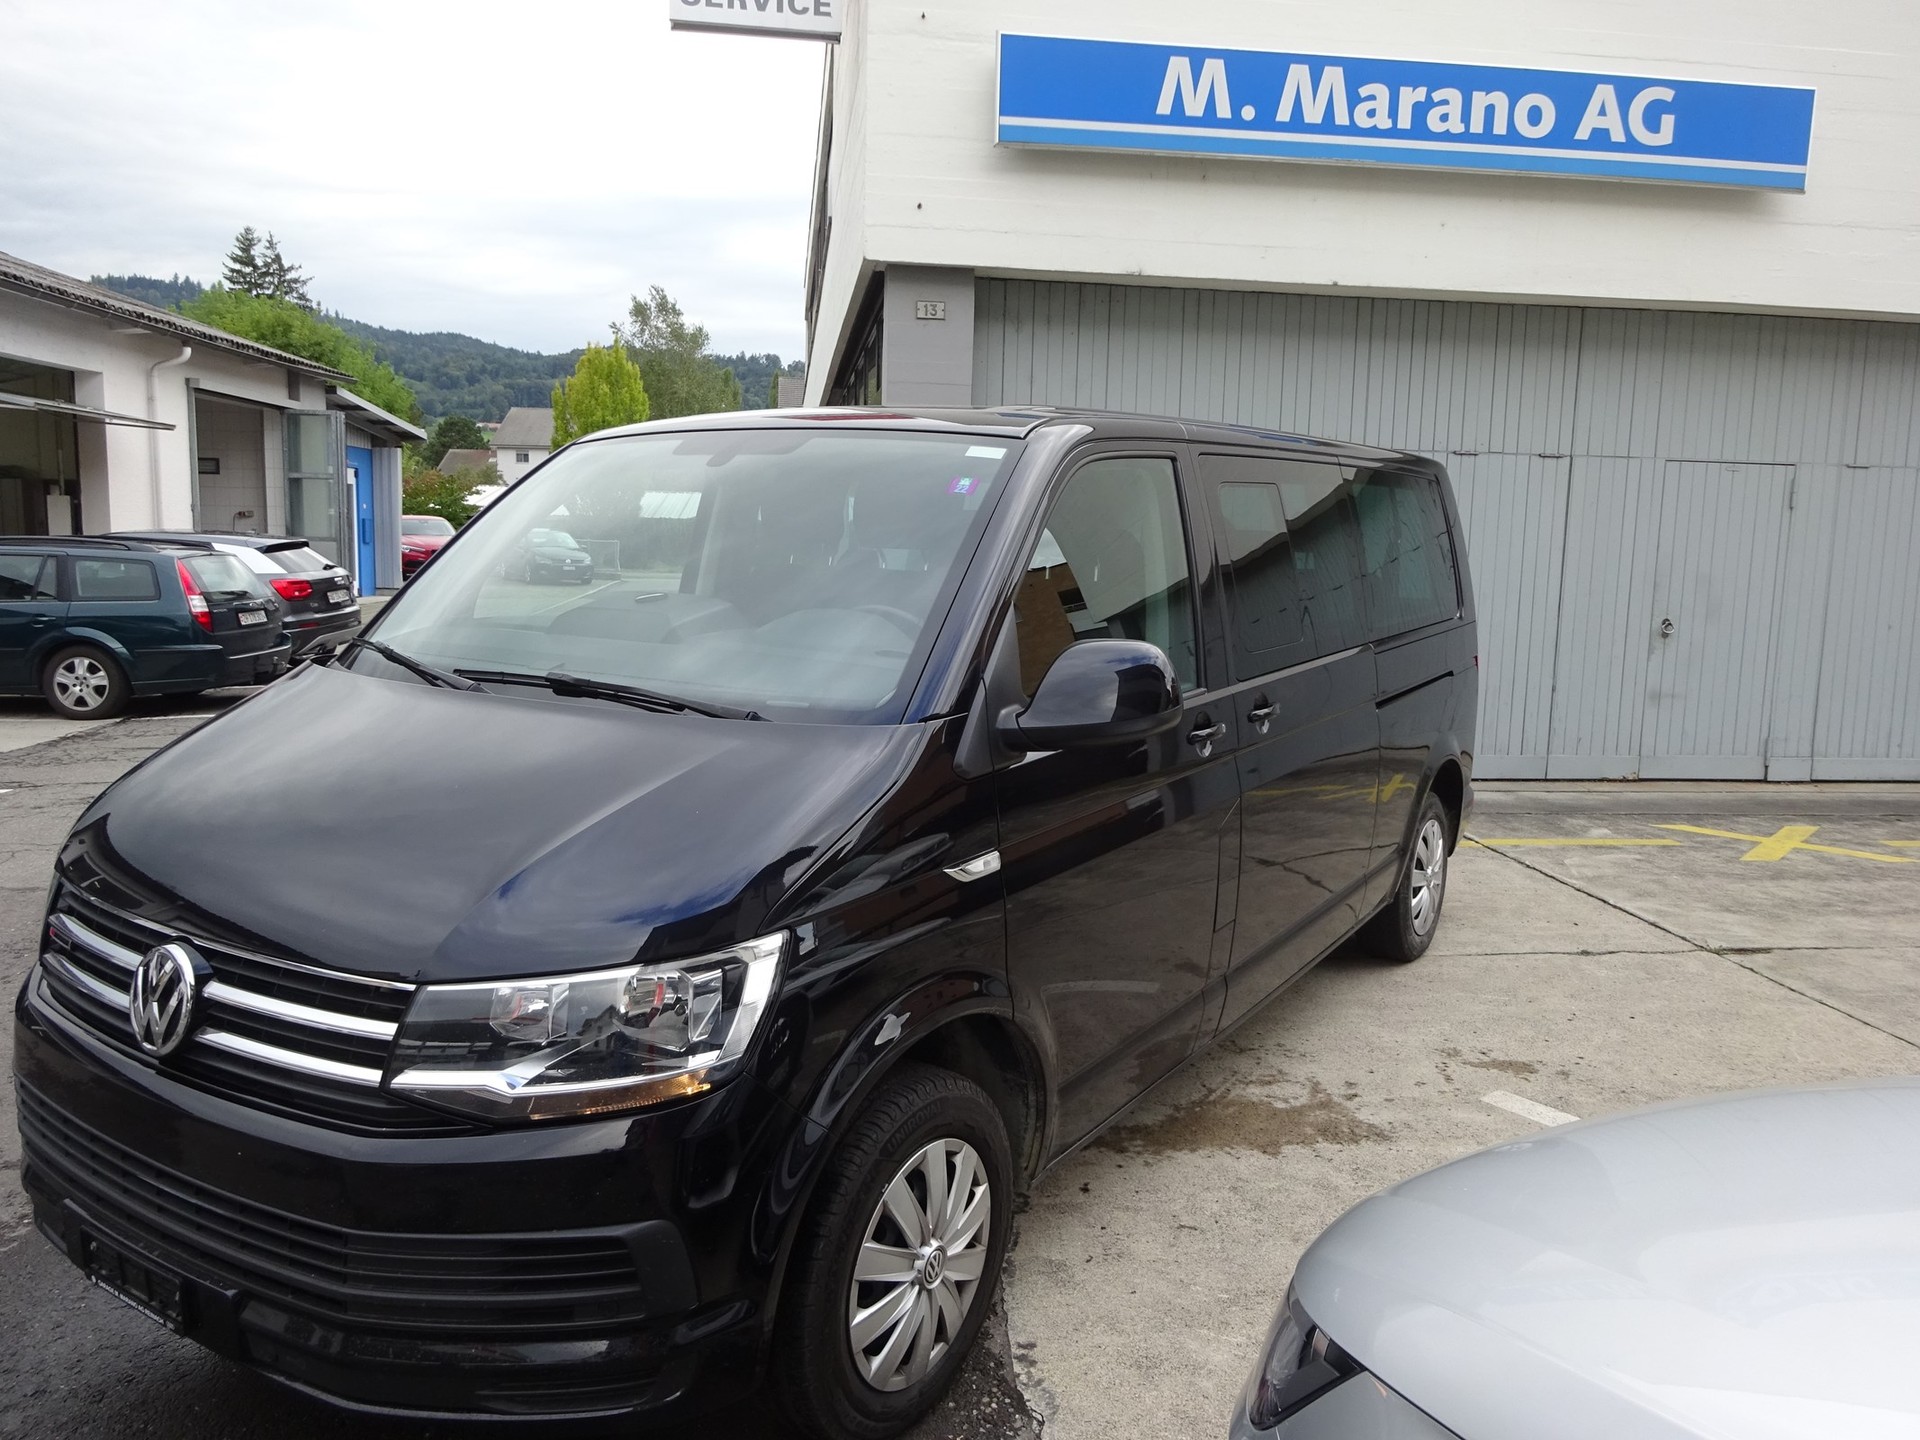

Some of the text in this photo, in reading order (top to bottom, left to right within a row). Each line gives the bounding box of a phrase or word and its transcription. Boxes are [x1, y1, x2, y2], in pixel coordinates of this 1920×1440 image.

[1155, 55, 1676, 147] M. Marano AG
[923, 303, 938, 317] 13
[953, 485, 969, 494] 22
